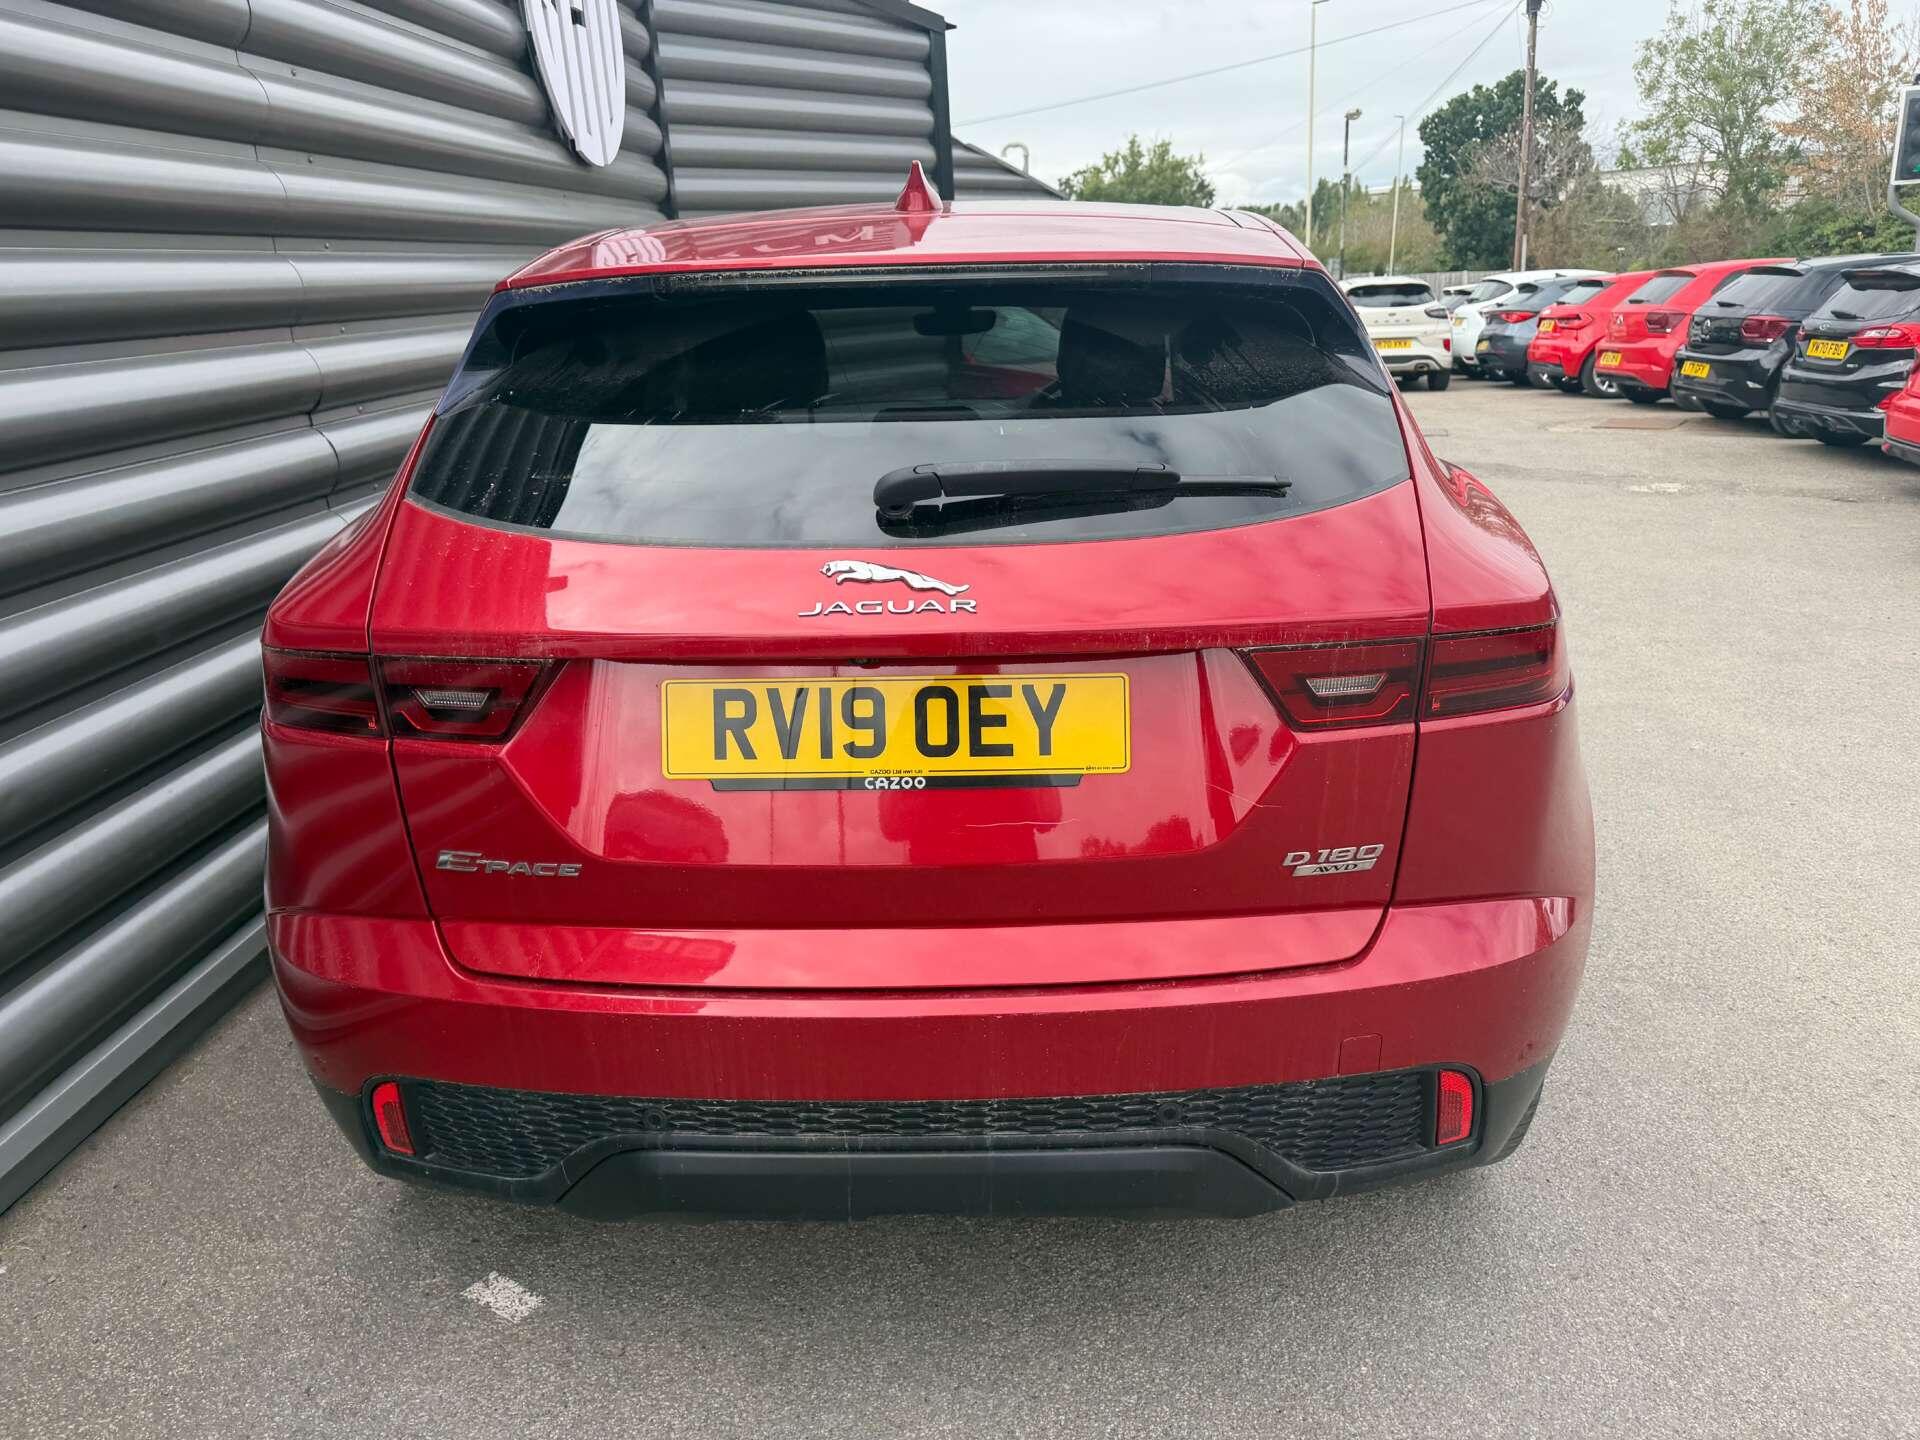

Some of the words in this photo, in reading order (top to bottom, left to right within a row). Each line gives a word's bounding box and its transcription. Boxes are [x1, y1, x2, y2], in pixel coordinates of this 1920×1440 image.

[798, 599, 977, 616] JAGUAR
[713, 686, 887, 760] RV19
[915, 683, 1067, 758] OEY
[864, 776, 926, 790] CAZOO
[1311, 863, 1358, 874] AWD
